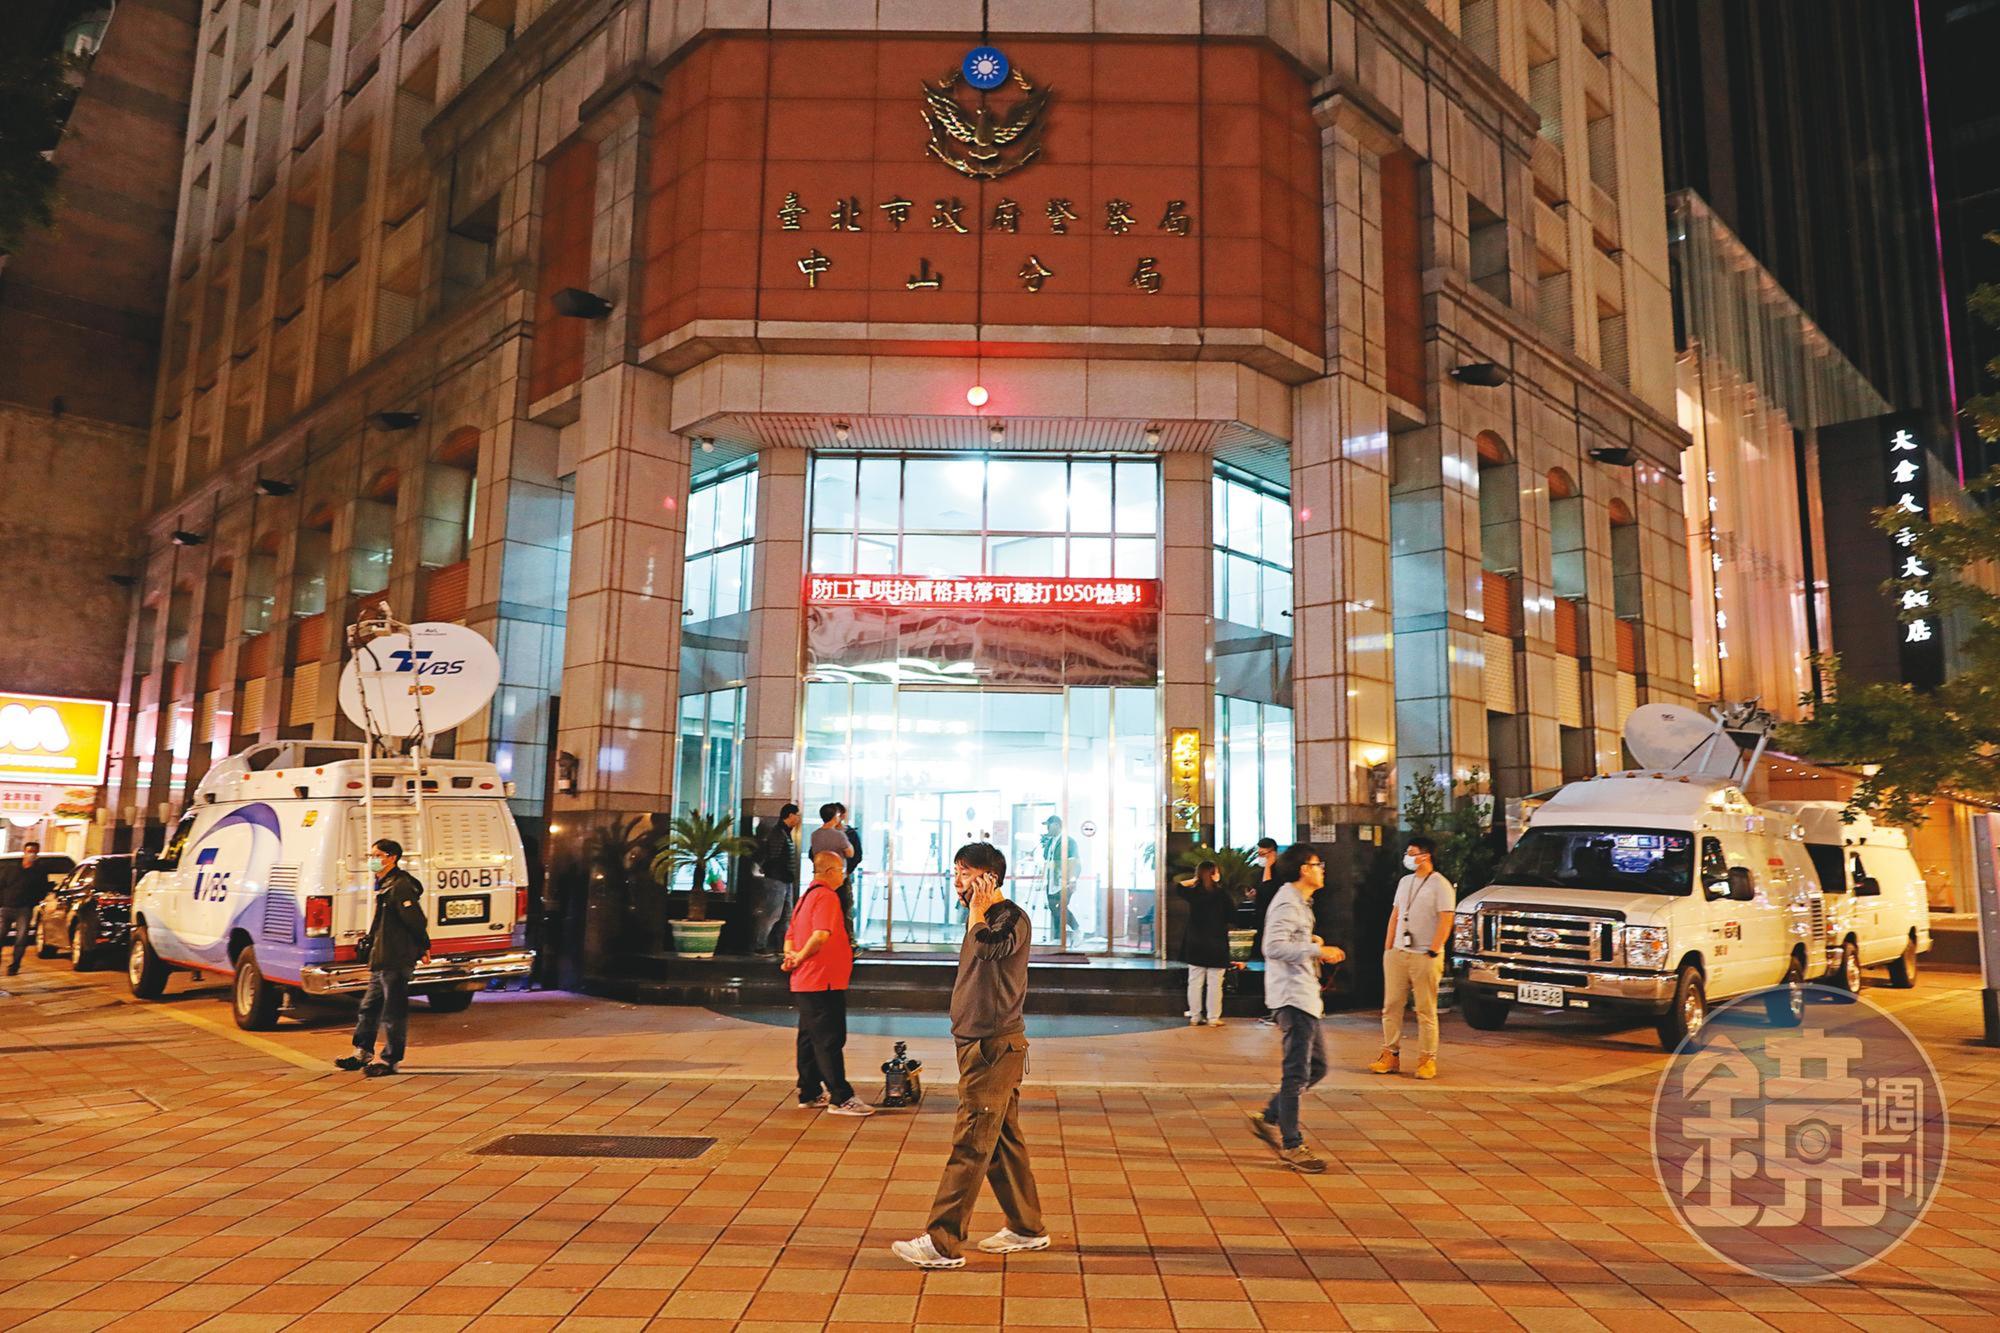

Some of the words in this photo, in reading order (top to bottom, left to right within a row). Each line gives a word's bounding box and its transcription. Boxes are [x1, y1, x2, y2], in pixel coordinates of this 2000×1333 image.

[776, 191, 1193, 236] 臺北市政府警察局
[797, 248, 1163, 294] 中山分局
[389, 650, 465, 675] TVBS
[437, 868, 504, 889] 960-BT
